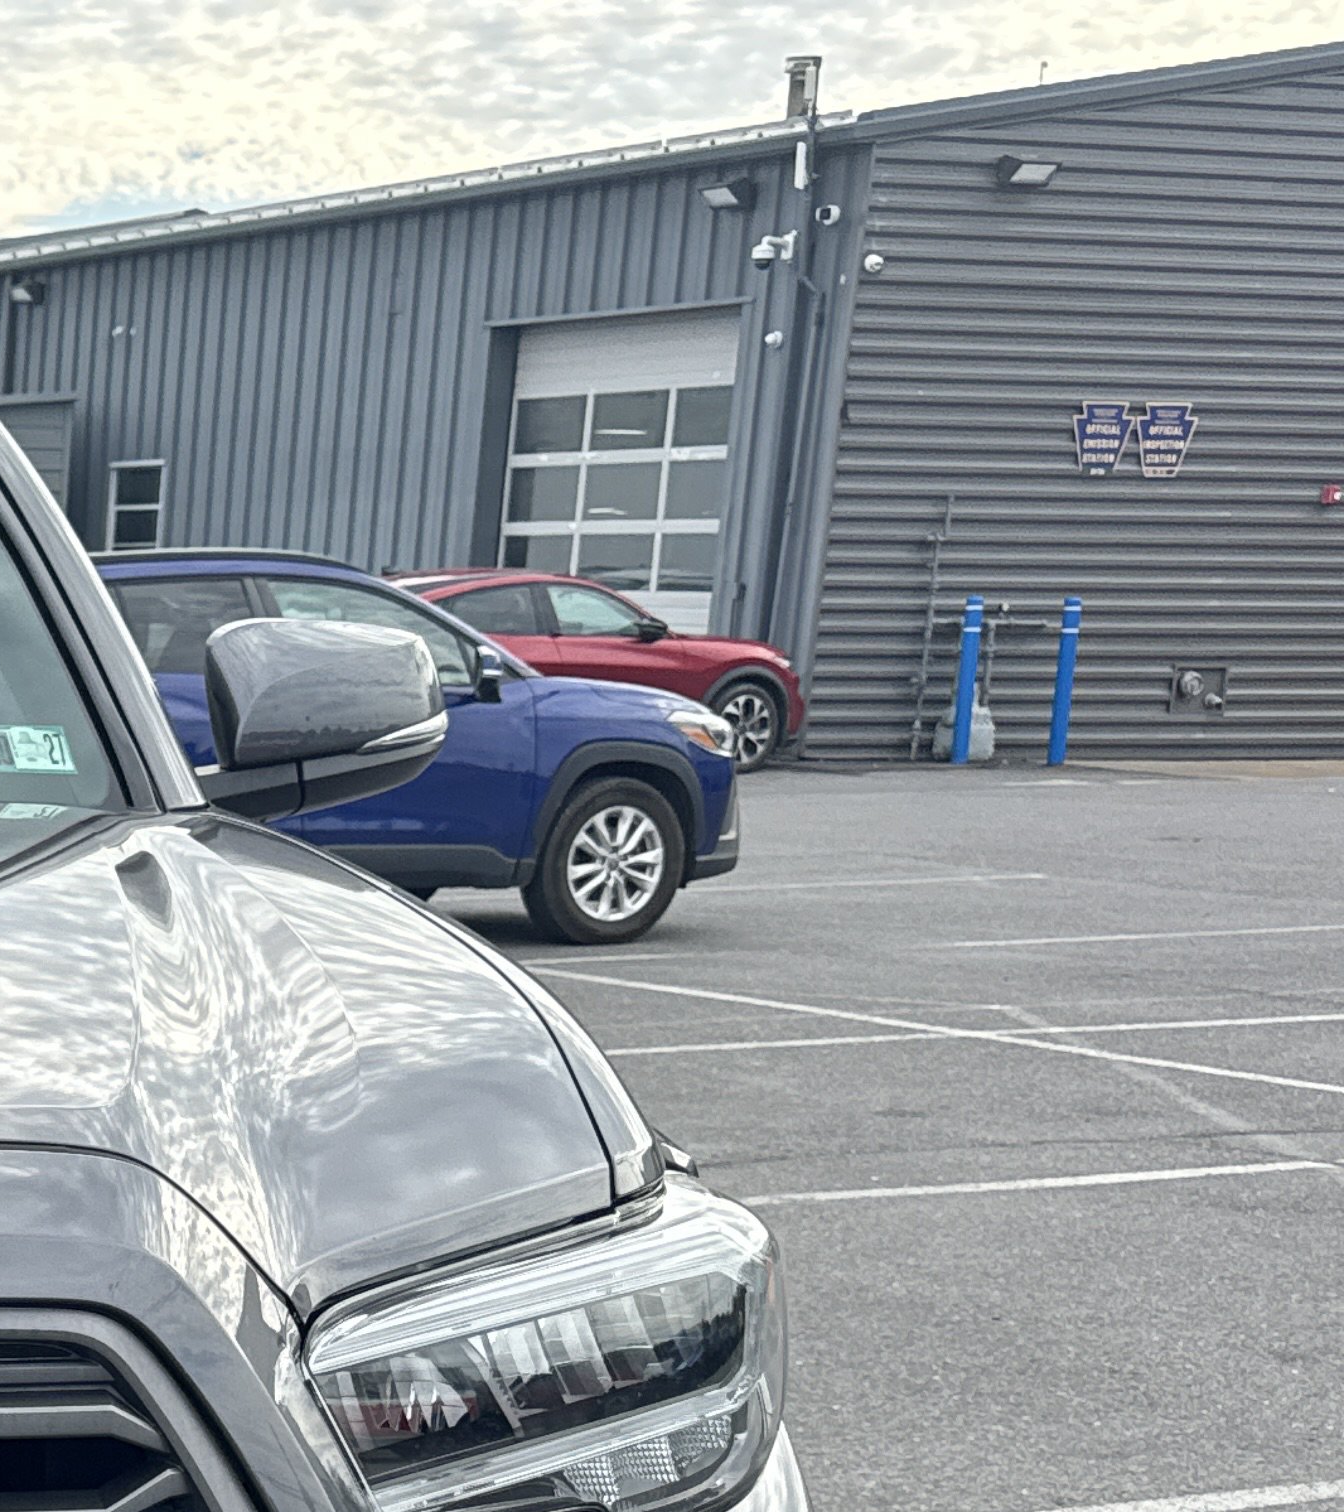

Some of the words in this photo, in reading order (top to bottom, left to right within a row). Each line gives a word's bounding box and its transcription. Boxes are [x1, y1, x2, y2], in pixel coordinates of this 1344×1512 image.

[1085, 424, 1121, 435] OFFICIAL
[1148, 425, 1184, 436] OFFICIAL
[1082, 453, 1115, 464] STATION
[1145, 453, 1177, 464] STATION
